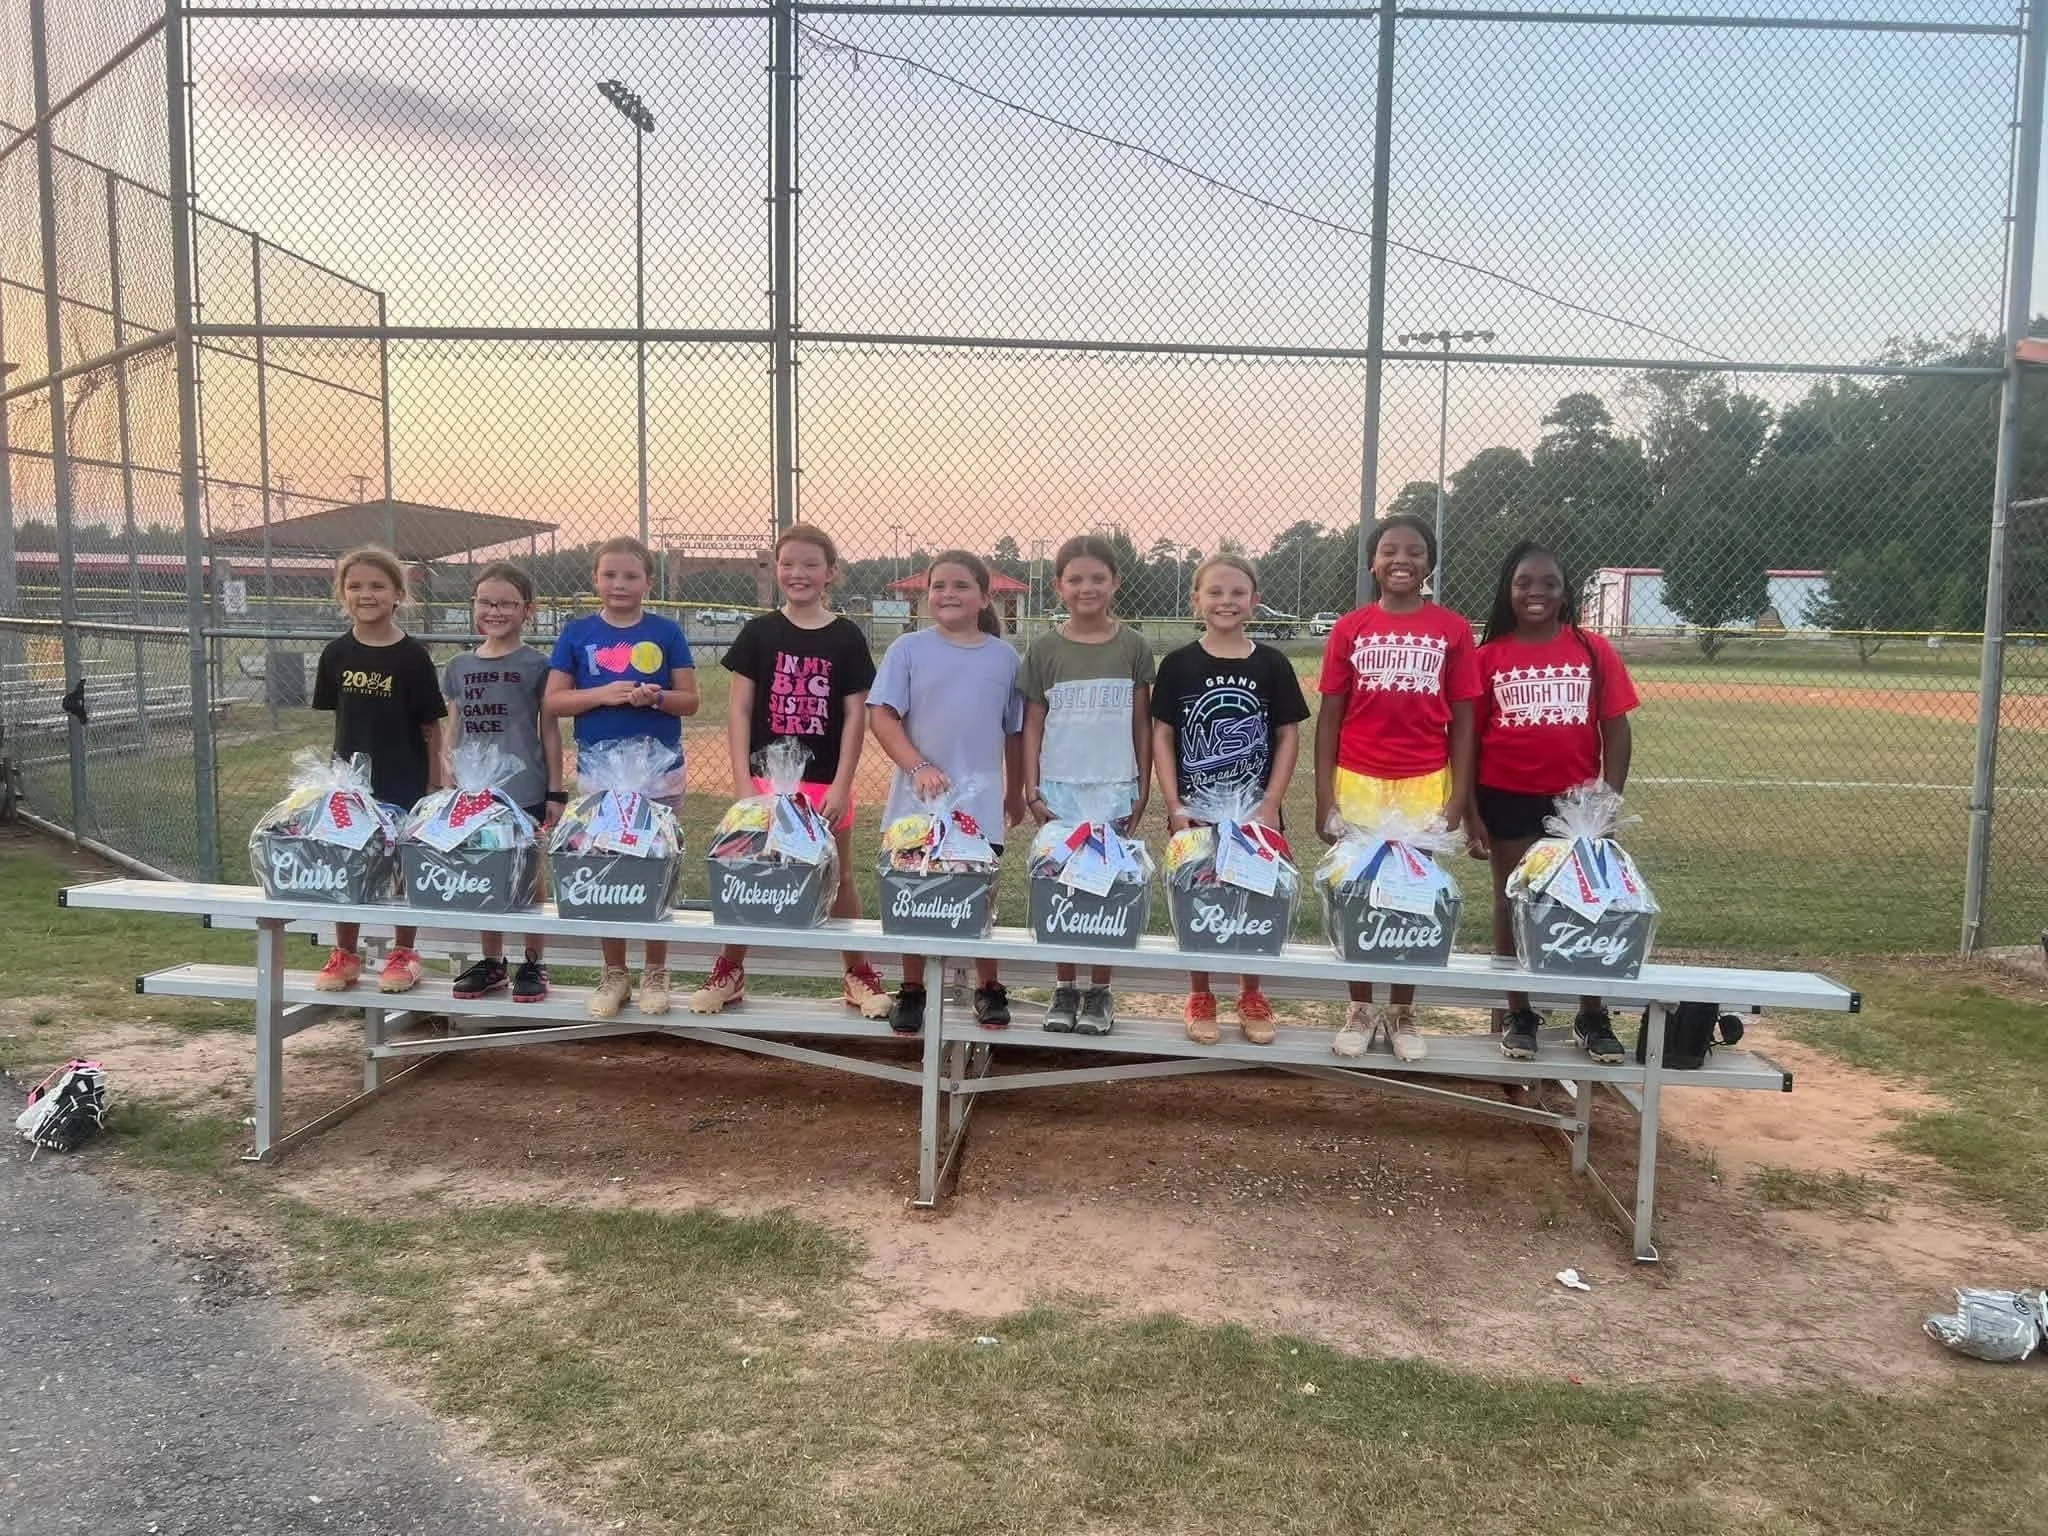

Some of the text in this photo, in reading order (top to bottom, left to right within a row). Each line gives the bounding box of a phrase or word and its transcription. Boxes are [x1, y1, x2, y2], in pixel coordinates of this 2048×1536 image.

[776, 651, 832, 676] IN MY
[1356, 649, 1441, 673] HAUGHTON
[342, 670, 392, 691] 204
[463, 671, 521, 685] THIS IS
[771, 672, 831, 697] BIG
[1205, 675, 1257, 690] GRAND
[769, 693, 829, 719] SISTER
[1501, 683, 1585, 707] HAUGHTON
[463, 704, 509, 717] GAME
[464, 720, 504, 734] FACE
[770, 713, 825, 735] ERA
[271, 850, 349, 890] Claire
[416, 861, 492, 901] Kylee
[568, 866, 647, 906] Emma
[721, 873, 801, 914] Mckenzie
[892, 888, 973, 928] Bradleigh
[1046, 894, 1128, 937] Kendall
[1190, 903, 1273, 944] Rylee
[1358, 910, 1442, 951] Jaicee
[1541, 922, 1628, 966] Zoey
